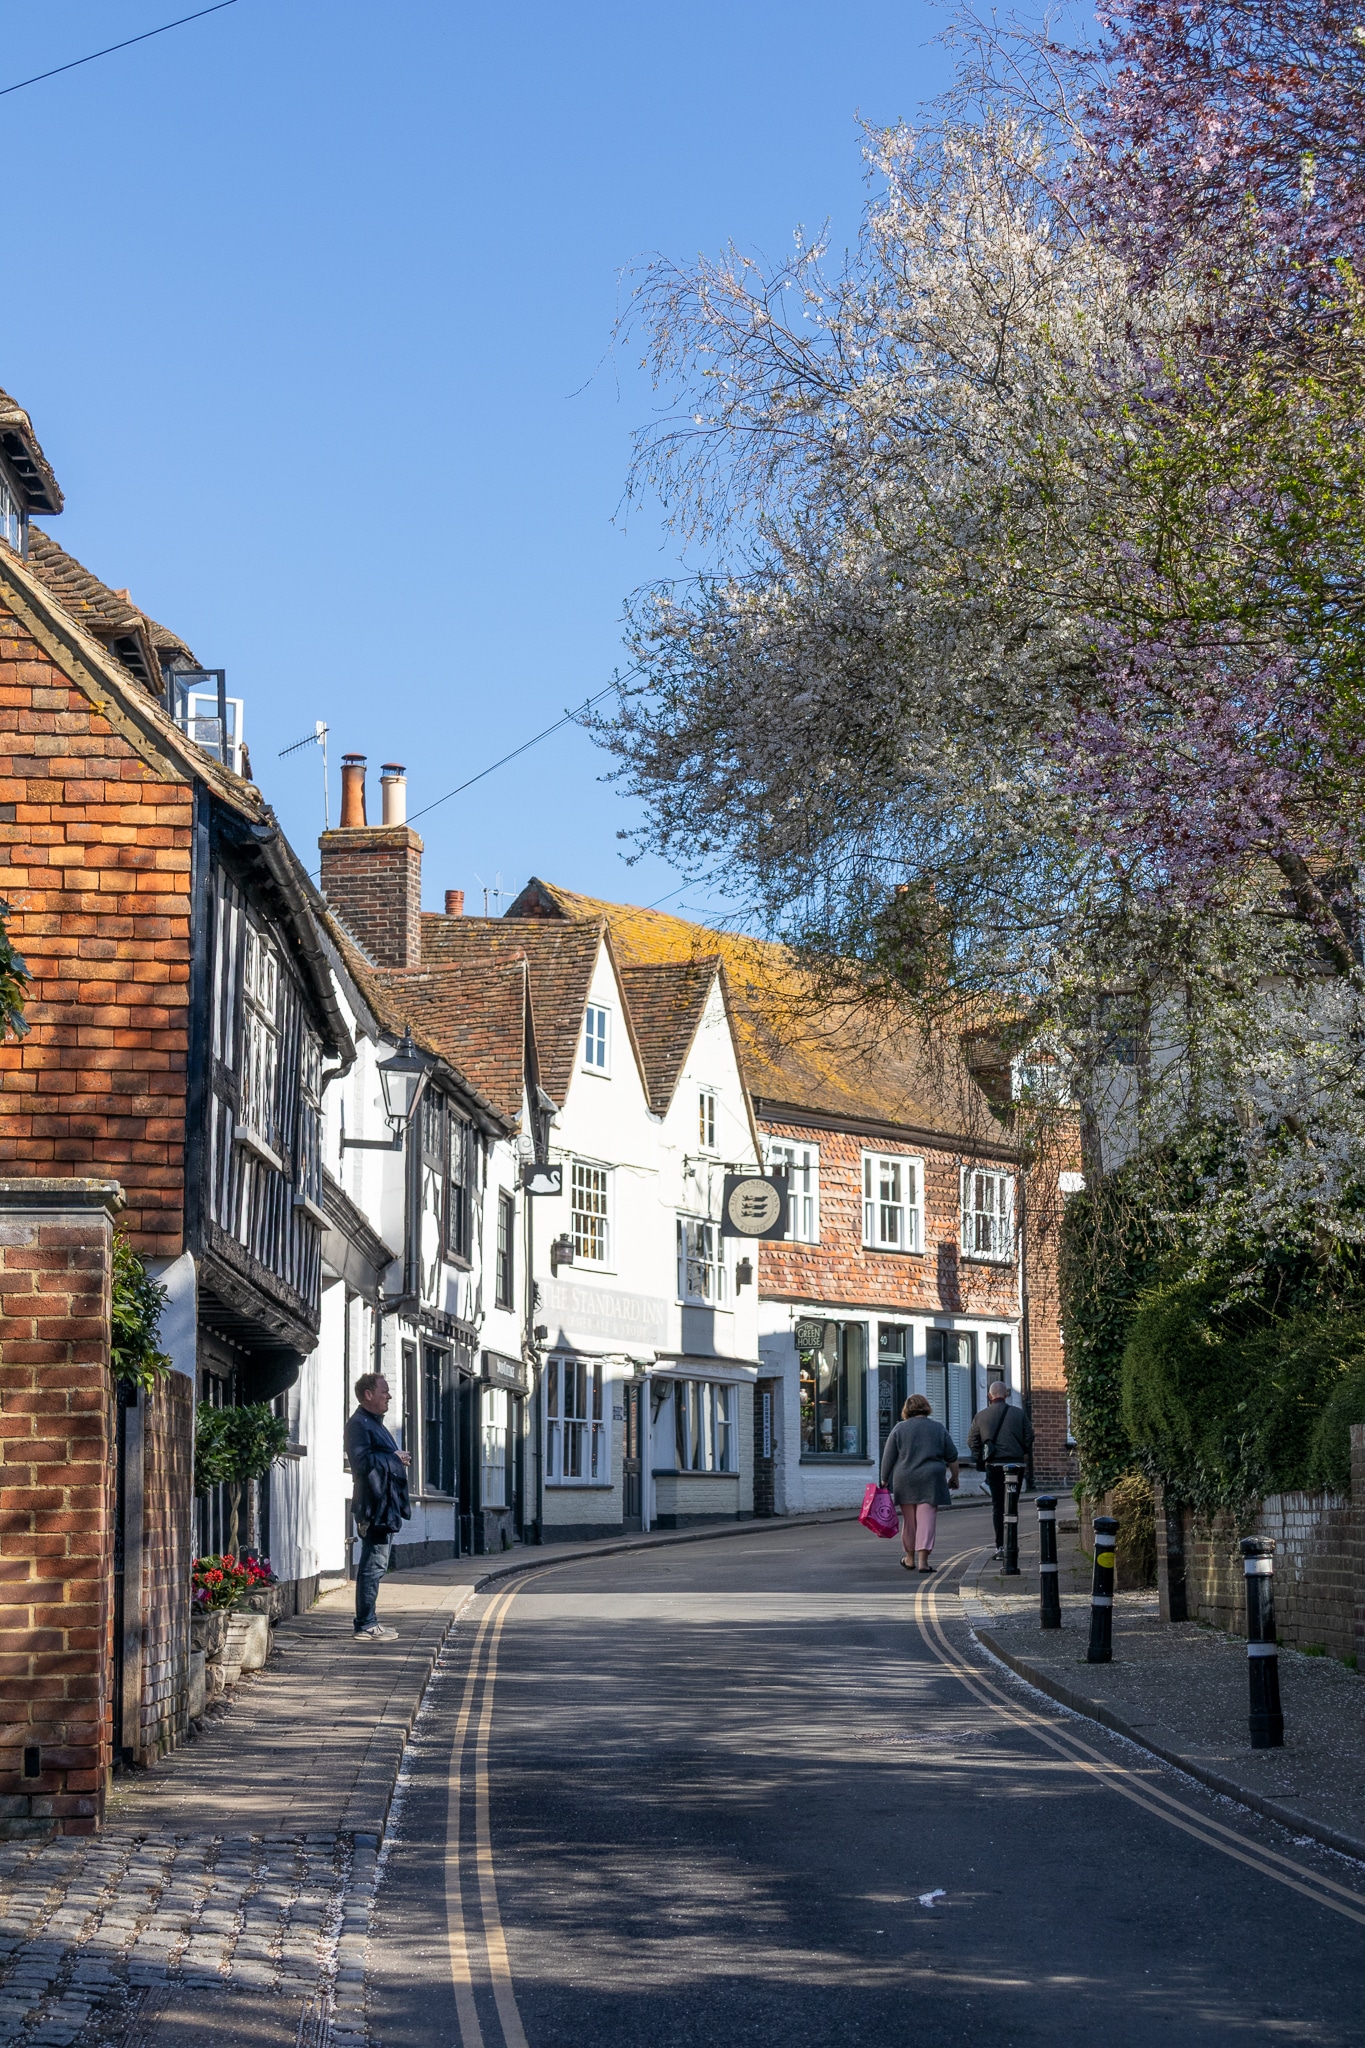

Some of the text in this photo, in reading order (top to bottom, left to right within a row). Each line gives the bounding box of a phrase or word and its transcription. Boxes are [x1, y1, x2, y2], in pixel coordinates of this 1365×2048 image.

[739, 1180, 774, 1194] STANDARD
[542, 1281, 568, 1311] THE
[572, 1287, 641, 1321] STANDARD
[644, 1299, 665, 1325] INN
[798, 1328, 821, 1338] GREEN
[798, 1337, 821, 1347] HOUSE
[879, 1335, 888, 1345] 40
